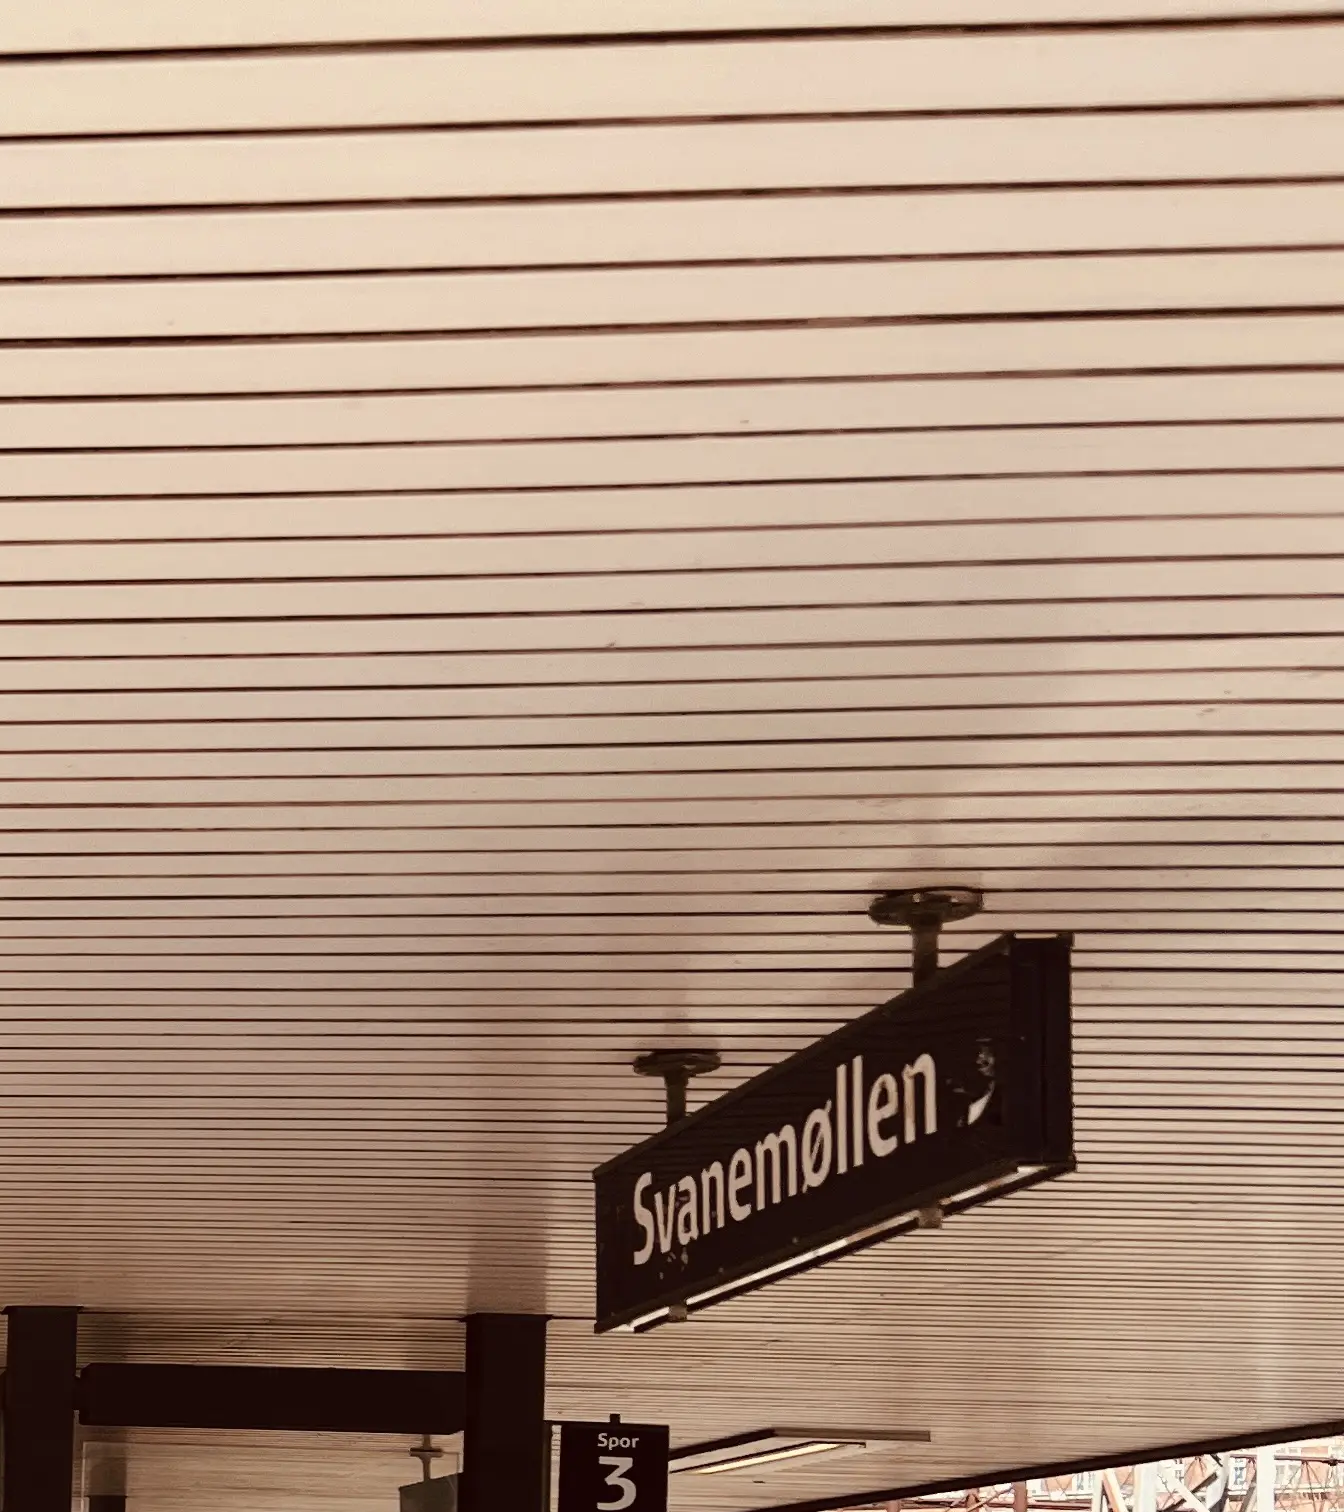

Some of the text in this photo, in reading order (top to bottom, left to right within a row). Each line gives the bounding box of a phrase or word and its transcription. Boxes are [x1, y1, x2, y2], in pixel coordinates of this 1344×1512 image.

[633, 1053, 938, 1265] Svanemøllen
[597, 1432, 640, 1450] Spor
[596, 1456, 637, 1511] 3
